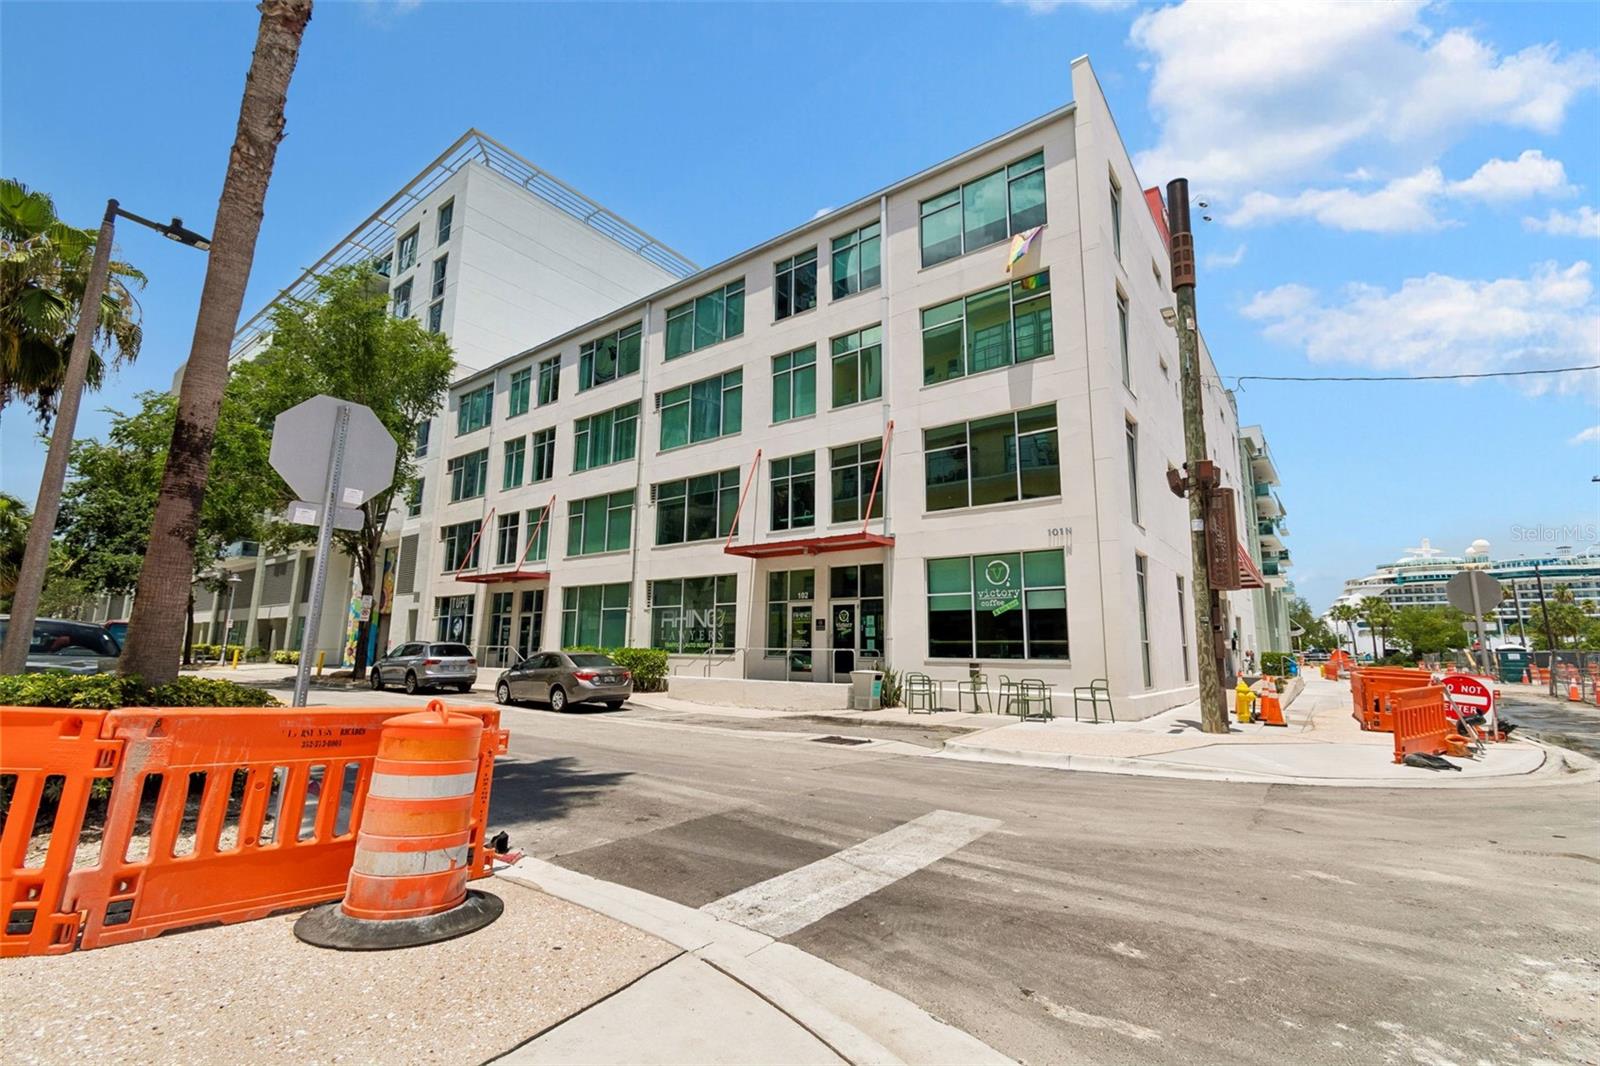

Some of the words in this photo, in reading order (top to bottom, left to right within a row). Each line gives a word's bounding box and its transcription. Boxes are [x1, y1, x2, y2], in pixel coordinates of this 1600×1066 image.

[977, 588, 1020, 599] victory
[980, 599, 1005, 607] coffee
[661, 608, 725, 628] RHINO
[661, 630, 723, 641] LAWYERS
[1461, 685, 1482, 695] NOT
